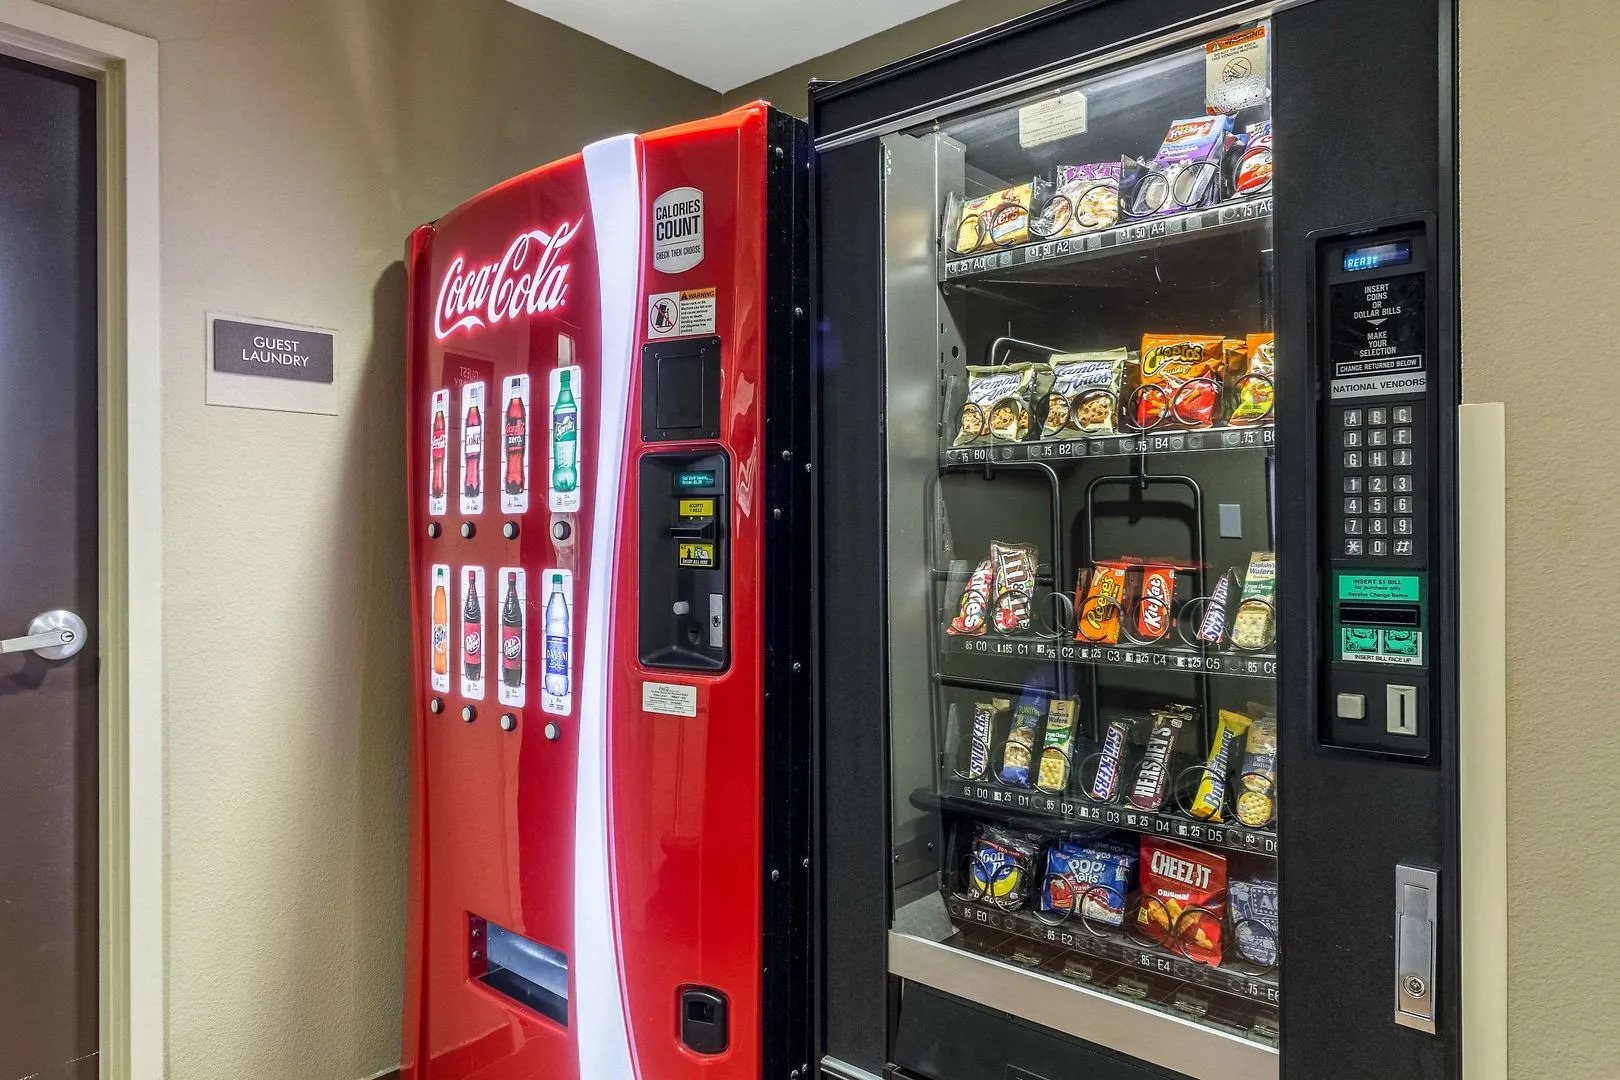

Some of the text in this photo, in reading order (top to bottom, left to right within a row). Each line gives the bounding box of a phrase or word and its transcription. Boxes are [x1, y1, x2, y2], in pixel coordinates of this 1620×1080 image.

[656, 199, 701, 221] CALORIES
[656, 215, 701, 241] COUNT
[1151, 222, 1165, 234] A4
[656, 245, 701, 260] CHECK THEN CHOOSE
[1057, 241, 1069, 253] A2
[434, 214, 585, 340] Coca-Cola
[688, 291, 715, 299] WARNING
[1364, 283, 1390, 294] INSERT
[1366, 292, 1388, 301] COINS
[1372, 300, 1382, 309] OR
[1354, 306, 1401, 320] DOLLAR BILLS
[1367, 331, 1387, 341] MAKE
[253, 336, 299, 353] GUEST
[1368, 339, 1387, 348] YOUR
[242, 348, 309, 367] LAUNDRY
[1143, 342, 1204, 375] Cheetos
[1359, 346, 1396, 358] SELECTION
[1055, 361, 1112, 378] Famous
[1340, 358, 1417, 373] CHANGE RETURNED BELOW
[969, 373, 1022, 393] Famous
[1062, 372, 1111, 395] Amos
[1333, 377, 1426, 394] NATIONAL VENDORS
[1349, 409, 1406, 424] A B C
[556, 420, 575, 437] Sprite
[1155, 438, 1168, 448] B4
[1349, 430, 1406, 445] D E F
[1059, 444, 1072, 454] B2
[1349, 452, 1405, 465] G H J
[1350, 477, 1406, 491] 1 2 3
[1349, 499, 1406, 511] 4 5 6
[1349, 519, 1406, 532] 7 8 9
[1373, 540, 1409, 552] 0 #
[1087, 576, 1114, 630] Reese's
[546, 649, 568, 661] DASANI
[1018, 643, 1028, 655] C1
[1062, 648, 1073, 658] C2
[1107, 650, 1120, 662] C3
[1153, 654, 1167, 665] C4
[1206, 657, 1220, 670] C5
[970, 707, 986, 774] SNICKERS
[1094, 727, 1121, 799] SNICKERS
[1133, 727, 1171, 798] HERSHEY'S
[977, 787, 988, 799] D0
[1018, 795, 1029, 807] D1
[1043, 799, 1073, 816] .85 D2
[1107, 811, 1120, 823] D3
[1155, 819, 1169, 832] D4
[1208, 828, 1223, 842] D5
[1061, 934, 1073, 946] E2
[1137, 954, 1171, 972] .85 E4
[1244, 983, 1258, 996] .75
